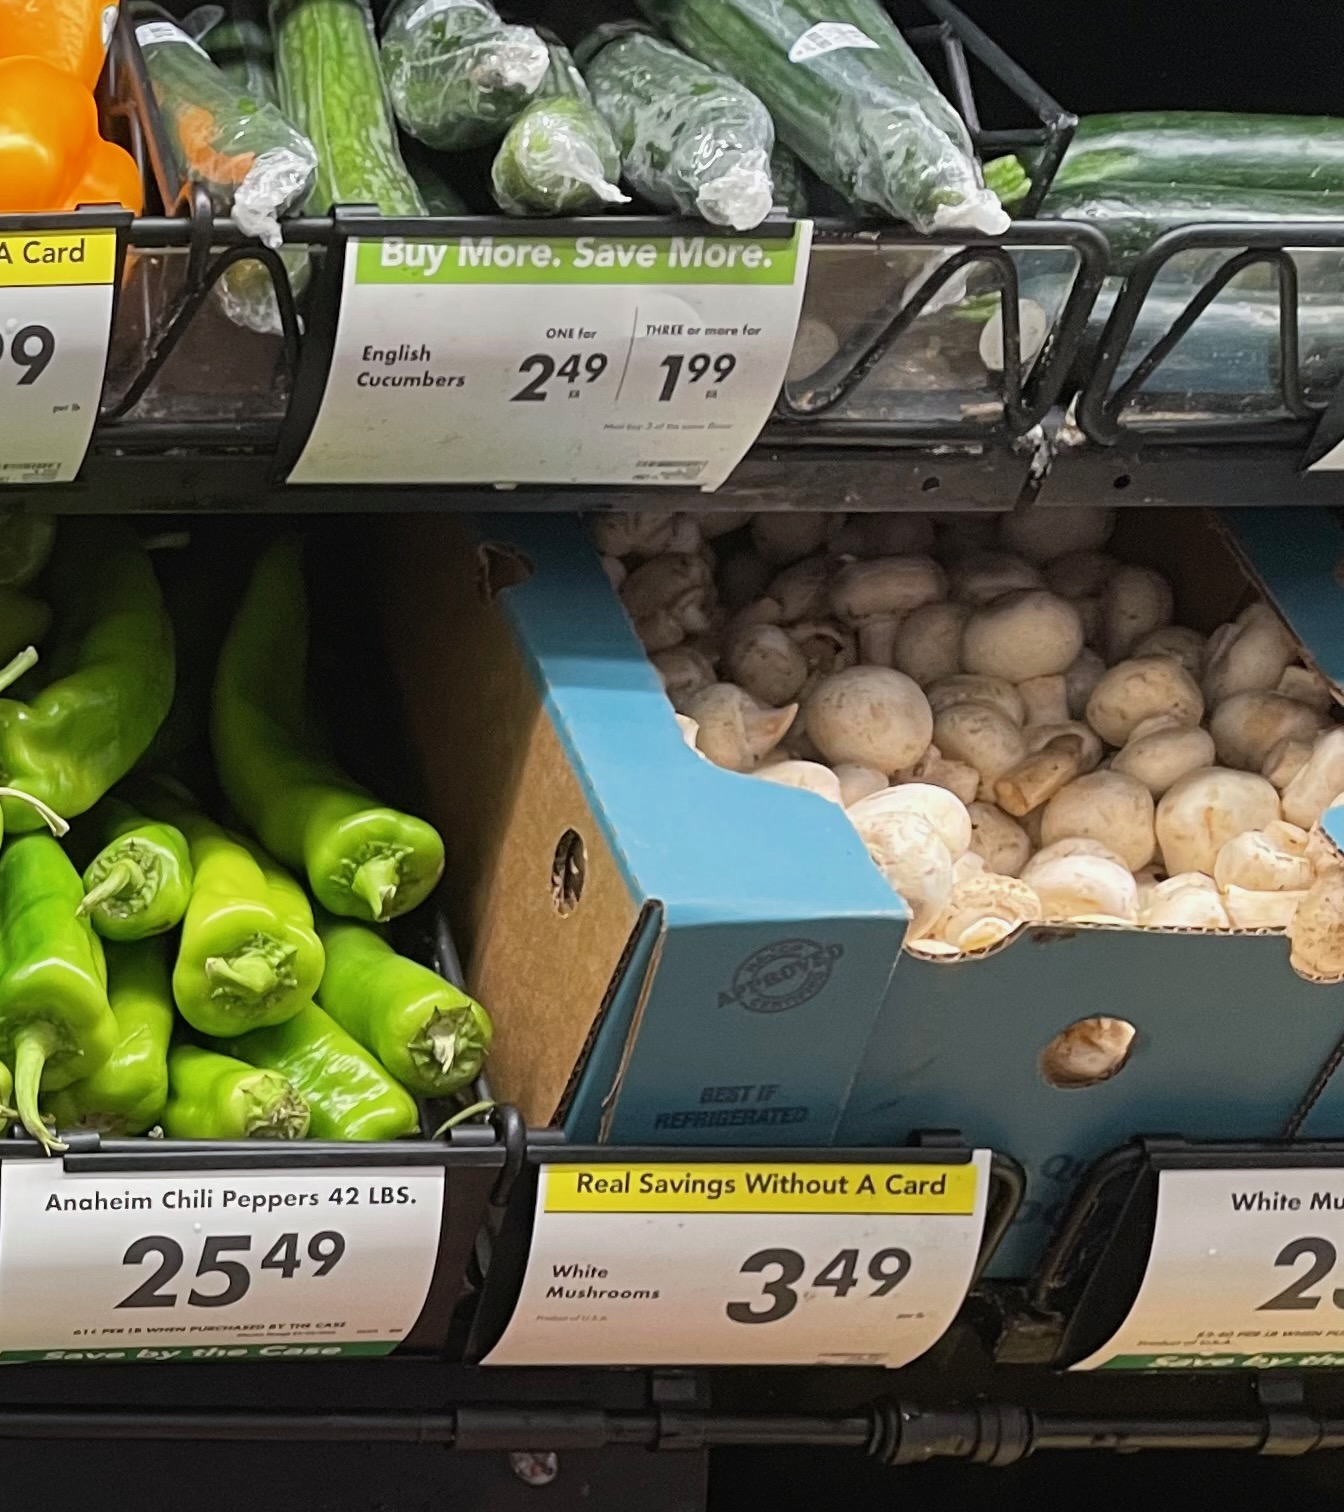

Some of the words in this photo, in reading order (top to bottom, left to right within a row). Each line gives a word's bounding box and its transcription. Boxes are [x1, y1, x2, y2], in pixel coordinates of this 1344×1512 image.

[380, 238, 445, 276] Buy
[459, 238, 561, 268] More.
[573, 238, 656, 268] Save
[668, 238, 772, 268] More.
[546, 328, 574, 338] ONE
[578, 328, 596, 339] for
[647, 325, 683, 335] THREE
[743, 324, 761, 335] for
[362, 344, 430, 365] English
[357, 371, 464, 387] Cucumbers
[700, 1085, 755, 1103] BEST
[759, 1085, 781, 1102] IF
[655, 1107, 809, 1129] REFRIGERATED
[45, 1191, 151, 1211] Anaheim
[163, 1189, 212, 1208] Chili
[223, 1191, 318, 1212] Peppers
[329, 1187, 359, 1205] 42
[370, 1187, 416, 1204] LBS.
[553, 1264, 608, 1278] White
[546, 1286, 659, 1299] Mushrooms
